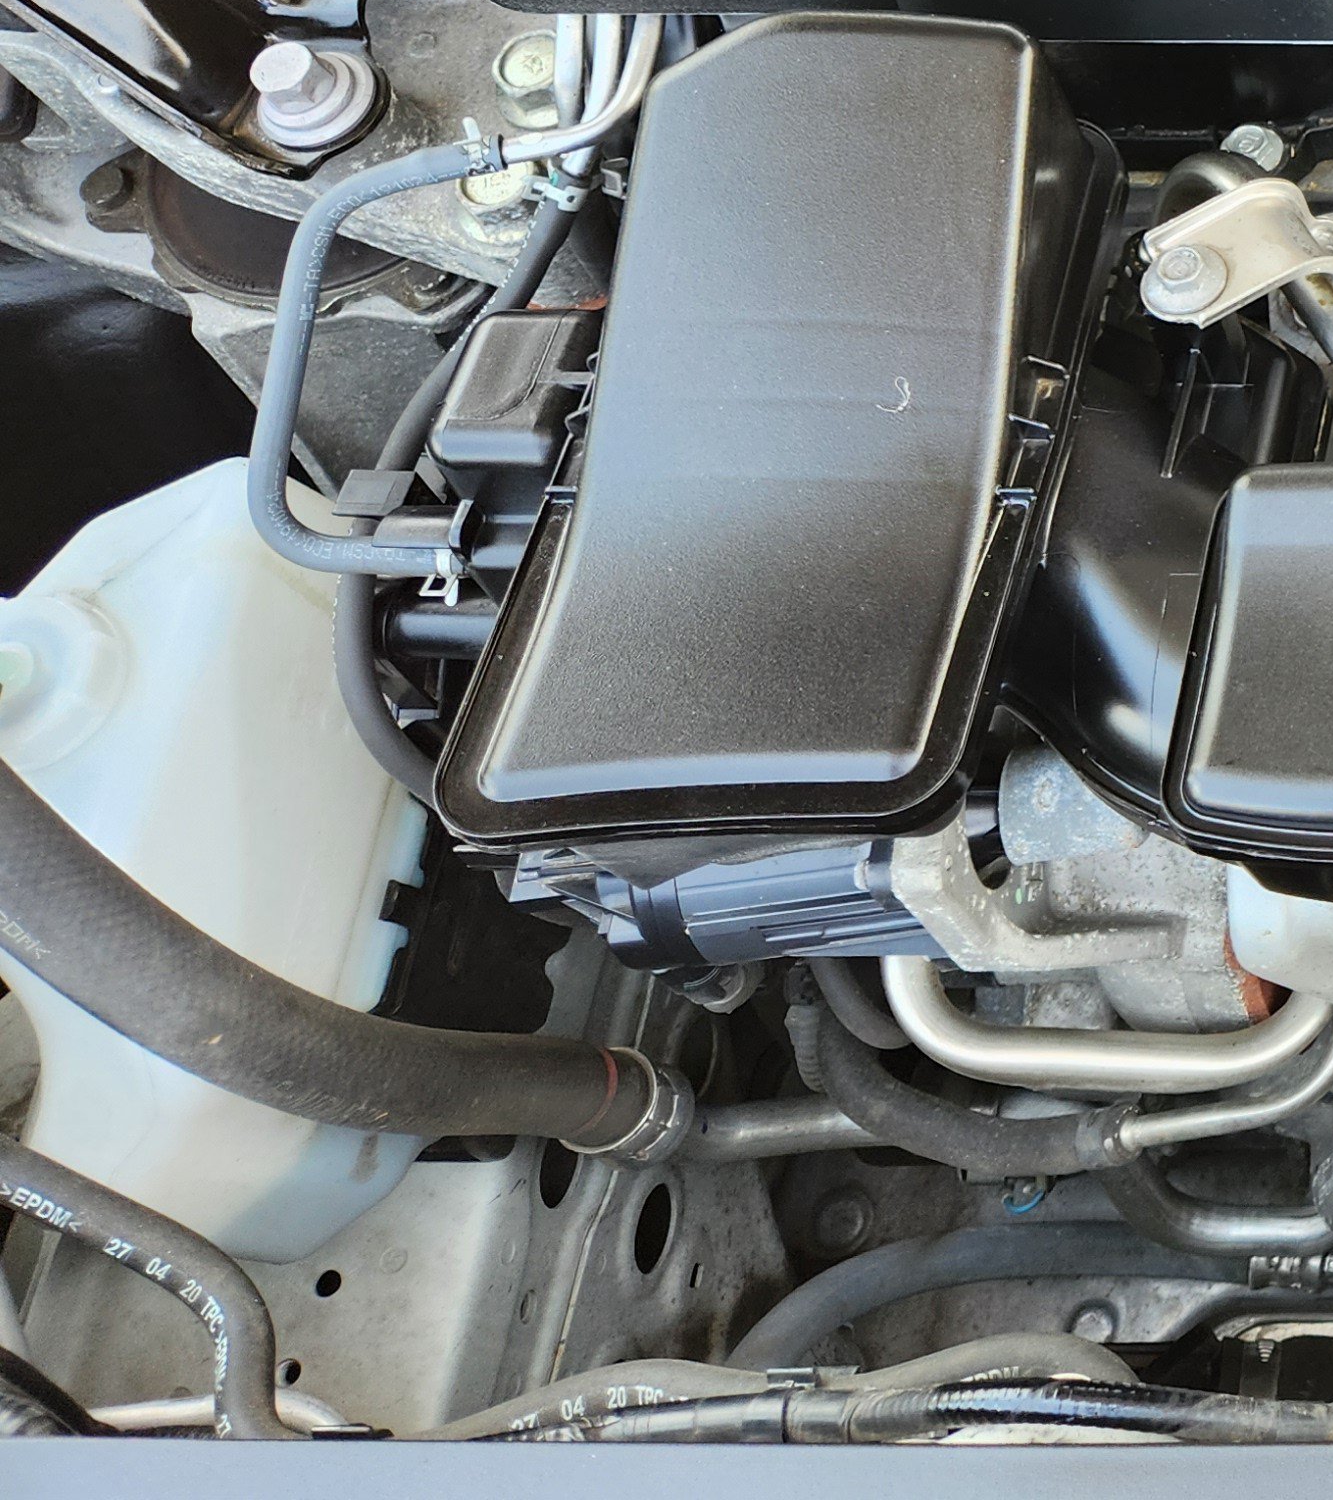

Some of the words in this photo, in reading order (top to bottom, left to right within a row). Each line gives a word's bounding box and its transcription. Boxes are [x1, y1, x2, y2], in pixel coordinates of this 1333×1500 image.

[103, 1236, 135, 1262] 27
[145, 1256, 173, 1281] 04
[178, 1278, 204, 1304] 20
[199, 1295, 226, 1333] TPC
[606, 1386, 627, 1410] 20
